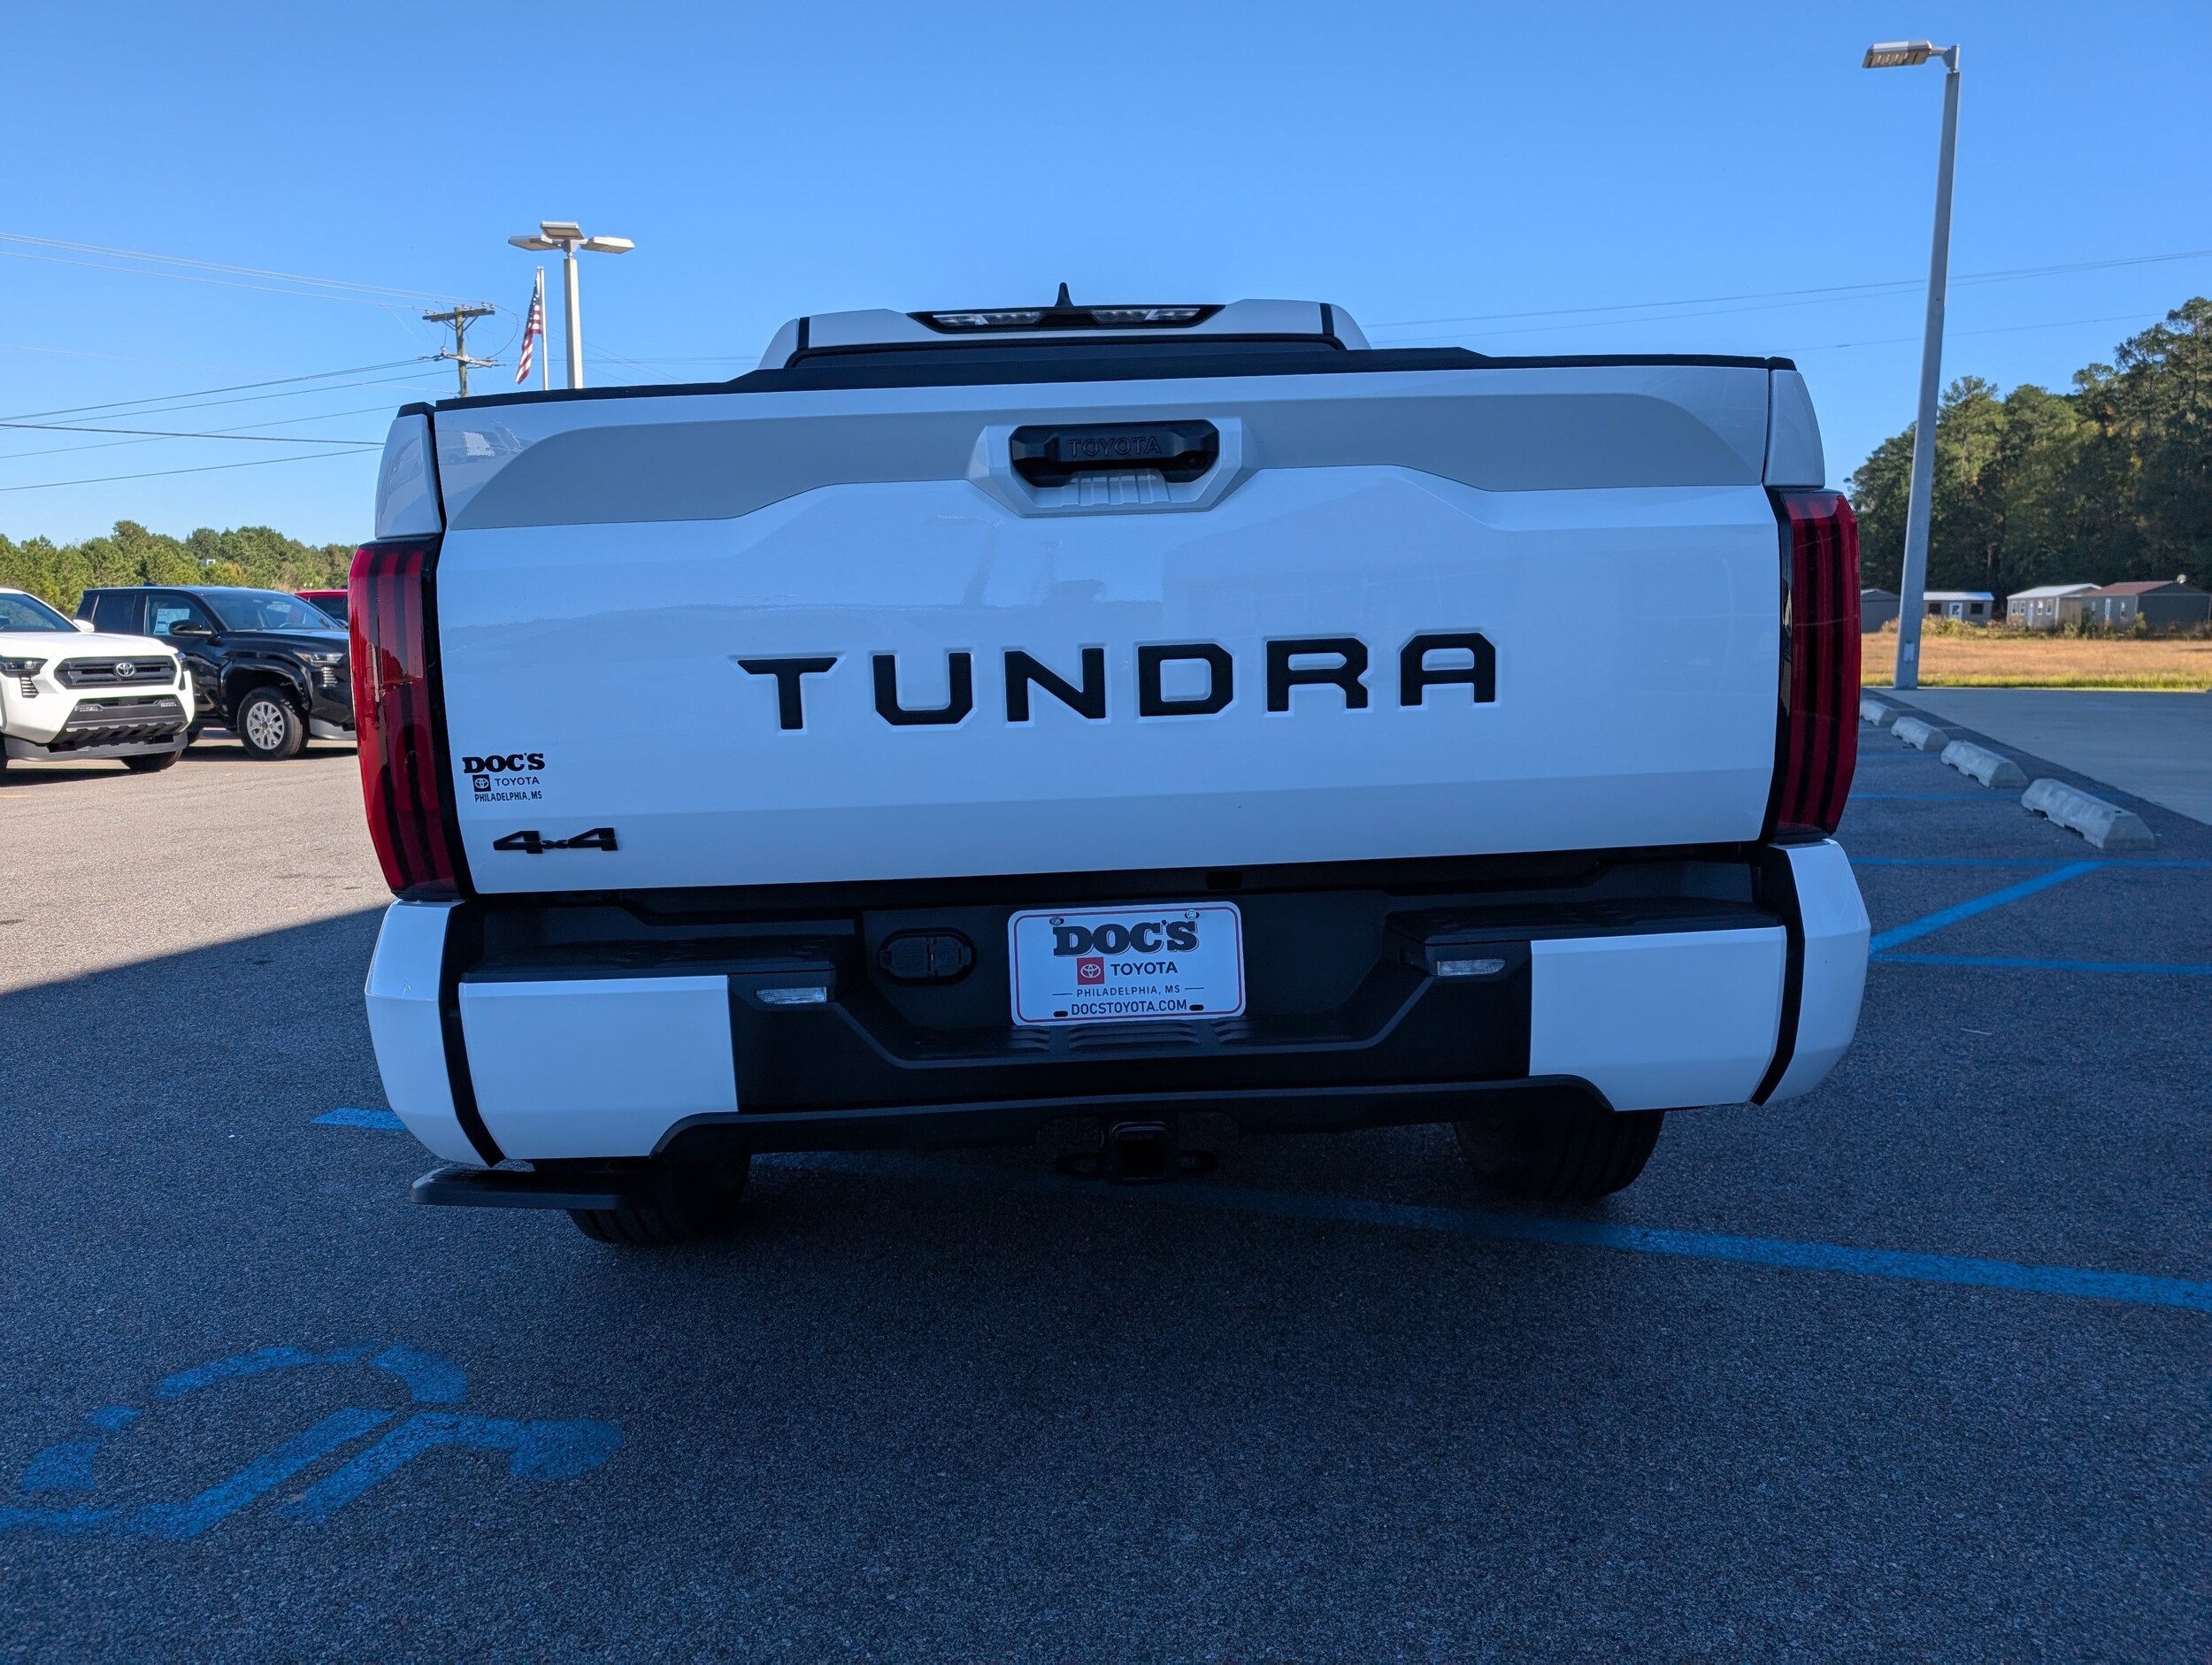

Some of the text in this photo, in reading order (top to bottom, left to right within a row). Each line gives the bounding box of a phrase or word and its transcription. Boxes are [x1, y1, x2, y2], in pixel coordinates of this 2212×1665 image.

[1067, 435, 1162, 457] TOYOTA
[737, 633, 1496, 731] TUNDRA
[461, 752, 546, 774] DOC'S
[494, 776, 540, 787] TOYOTA
[492, 827, 618, 854] 4x4
[1052, 918, 1201, 957] DOC'S
[1110, 961, 1179, 977] TOYOTA
[1076, 984, 1181, 998] PHILADELPHIA, MS
[1071, 999, 1187, 1016] DOCSTOYOTA.COM
